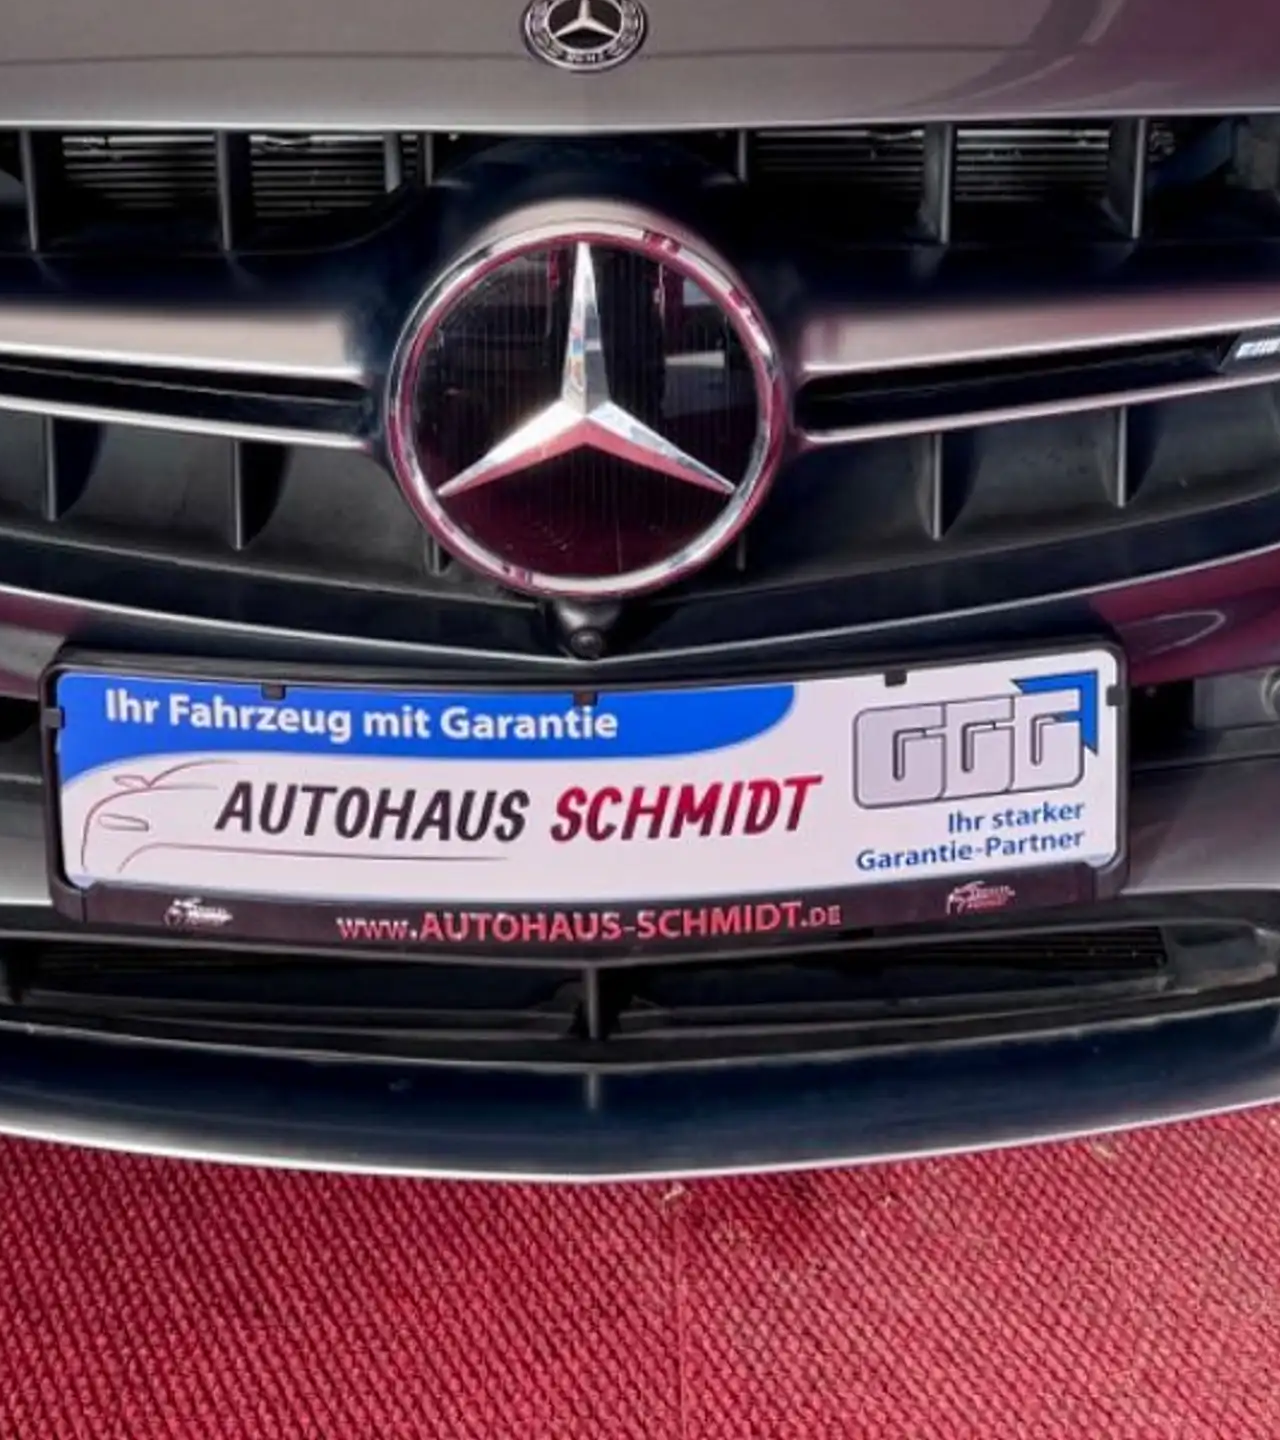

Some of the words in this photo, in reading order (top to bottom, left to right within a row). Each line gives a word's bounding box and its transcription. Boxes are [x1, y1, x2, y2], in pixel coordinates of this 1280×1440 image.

[105, 688, 160, 724] Ihr
[169, 693, 353, 744] Fahrzeug
[363, 703, 431, 739] mit
[440, 703, 619, 740] Garantie
[214, 779, 531, 843] AUTOHAUS
[550, 774, 824, 843] SCHMIDT
[947, 810, 986, 834] Ihr
[992, 800, 1086, 830] starker
[855, 830, 1086, 871] Garantie-Partner
[335, 900, 843, 942] www.AUTOHAUS-SCHMIDT.DE
